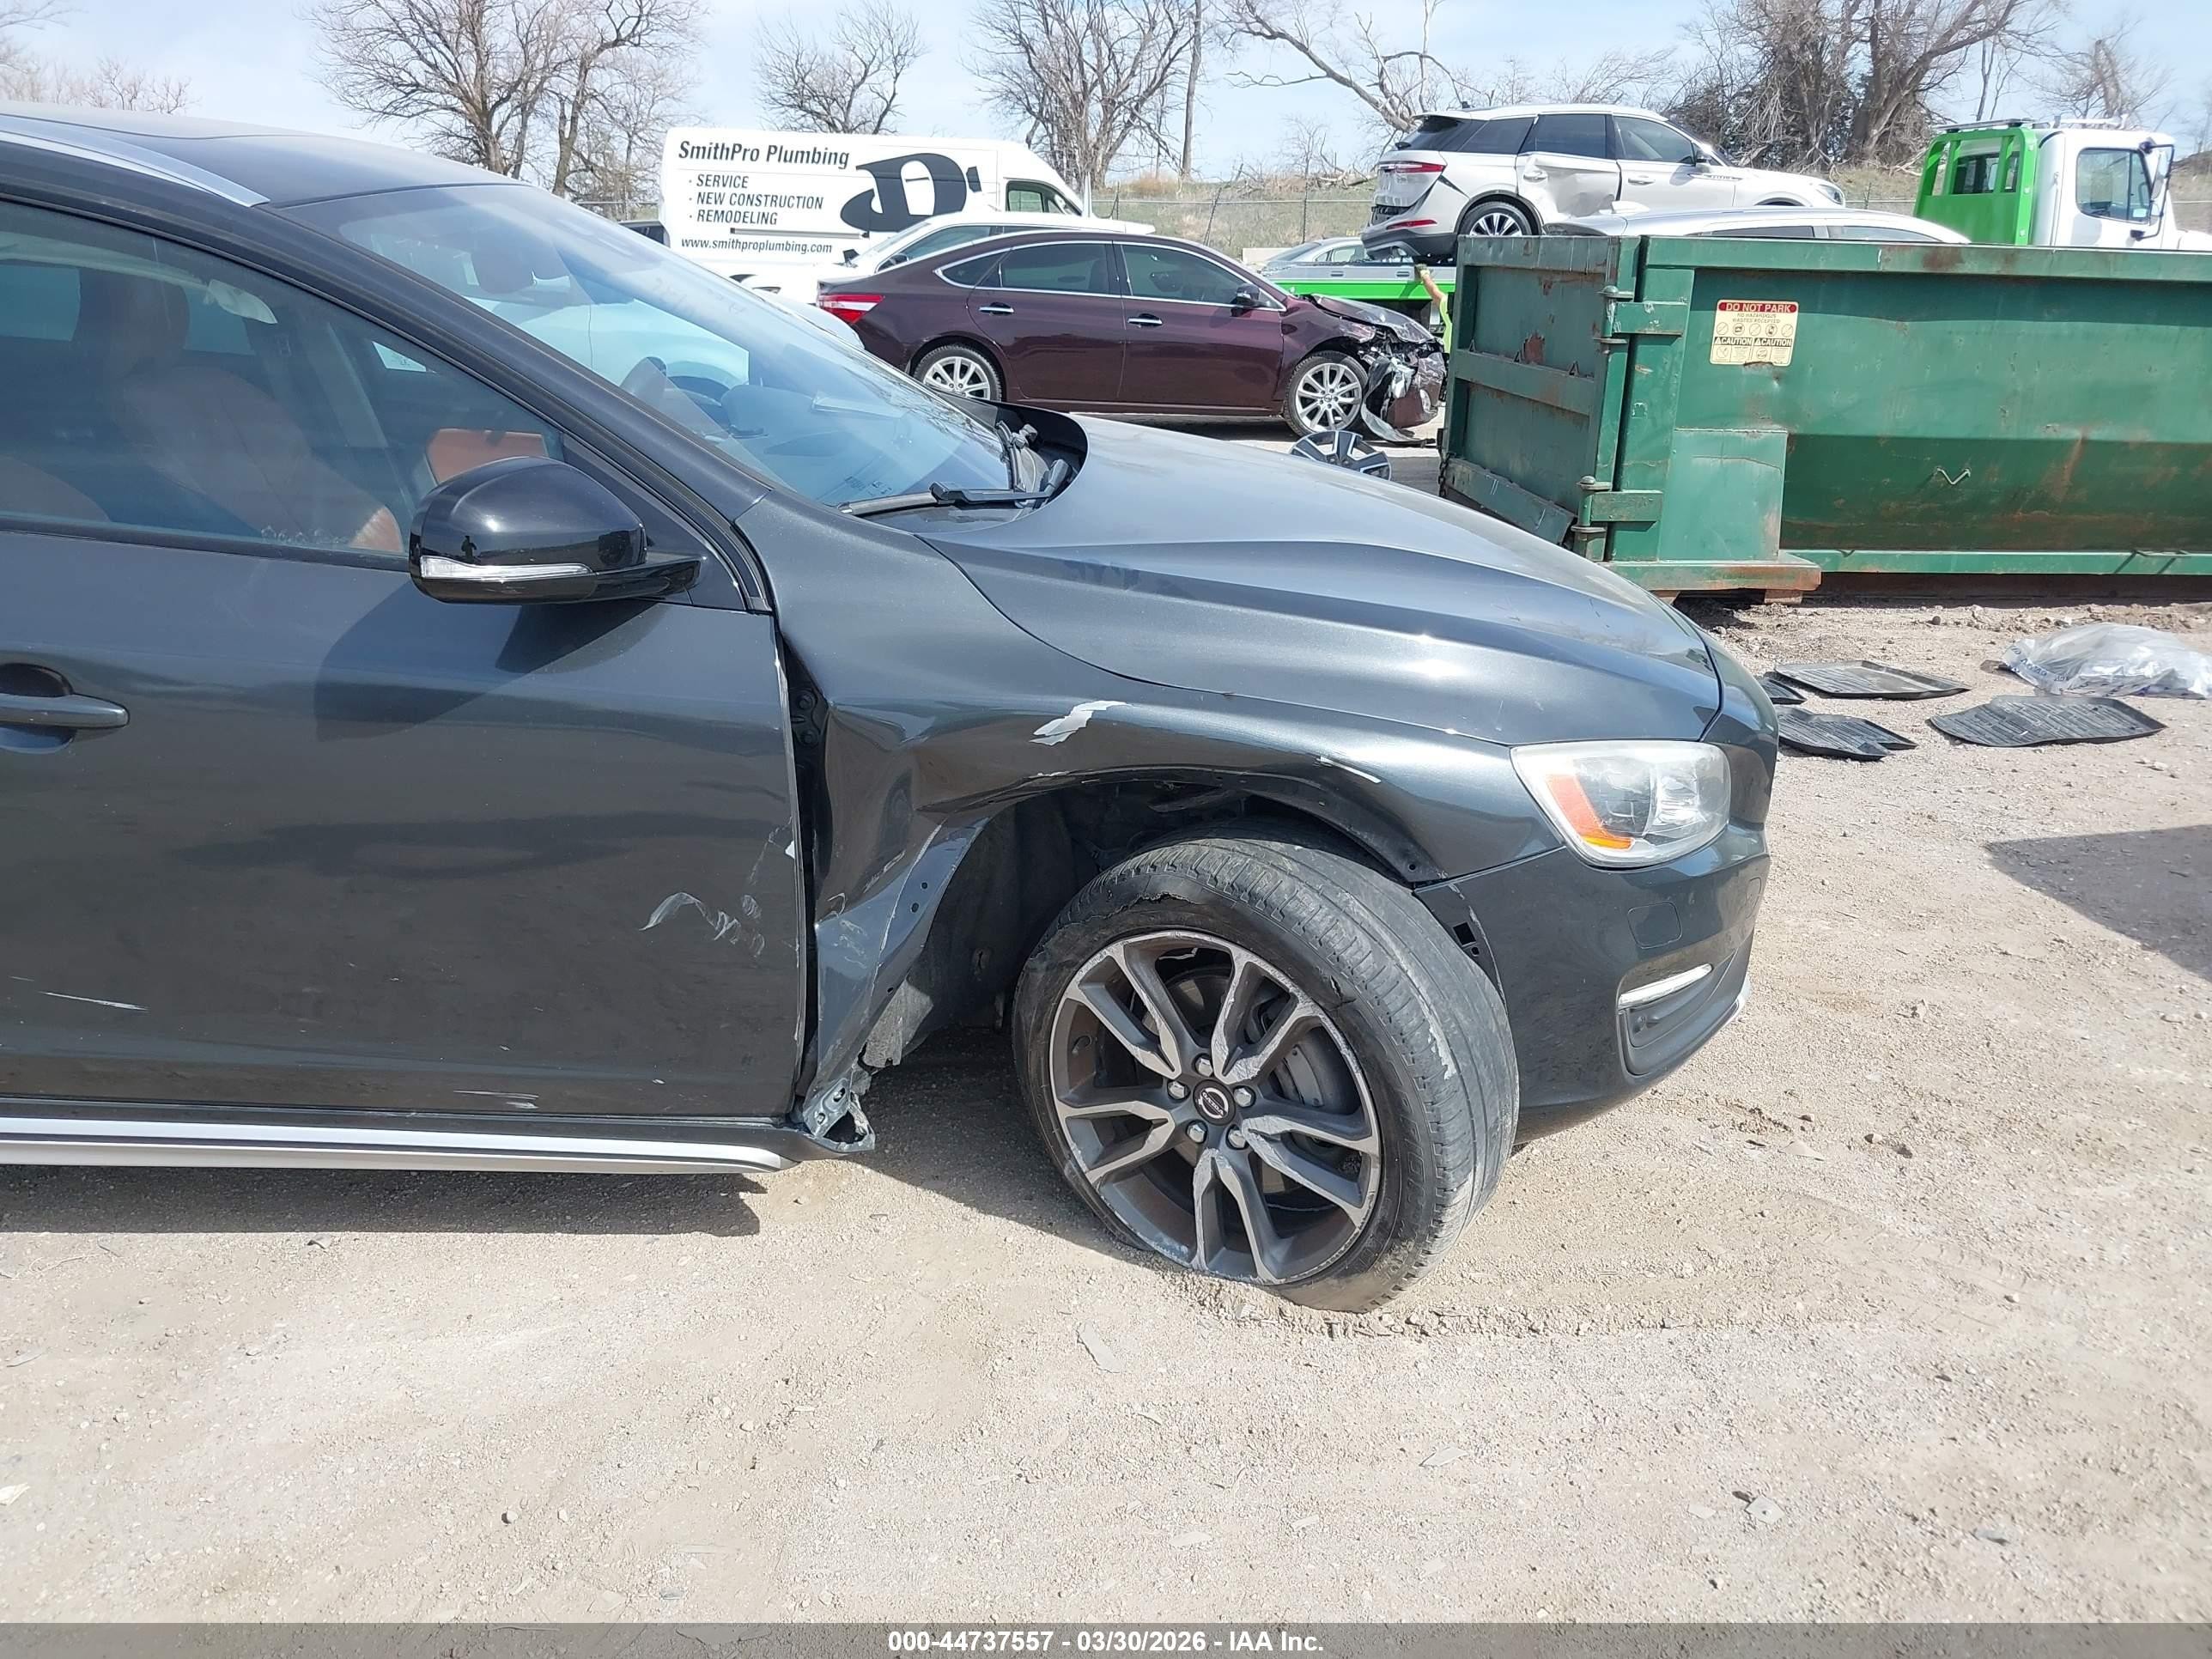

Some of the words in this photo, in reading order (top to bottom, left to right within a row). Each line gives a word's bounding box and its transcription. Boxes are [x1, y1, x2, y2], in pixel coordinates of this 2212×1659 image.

[678, 141, 760, 161] SmithPro
[766, 145, 849, 169] Plumbing
[696, 174, 749, 188] SERVICE
[696, 191, 725, 205] NEW
[729, 192, 823, 210] CONSTRUCTION
[696, 210, 778, 225] REMODELING
[681, 238, 832, 254] www.smithproplumbing.com
[1765, 304, 1790, 313] PARK
